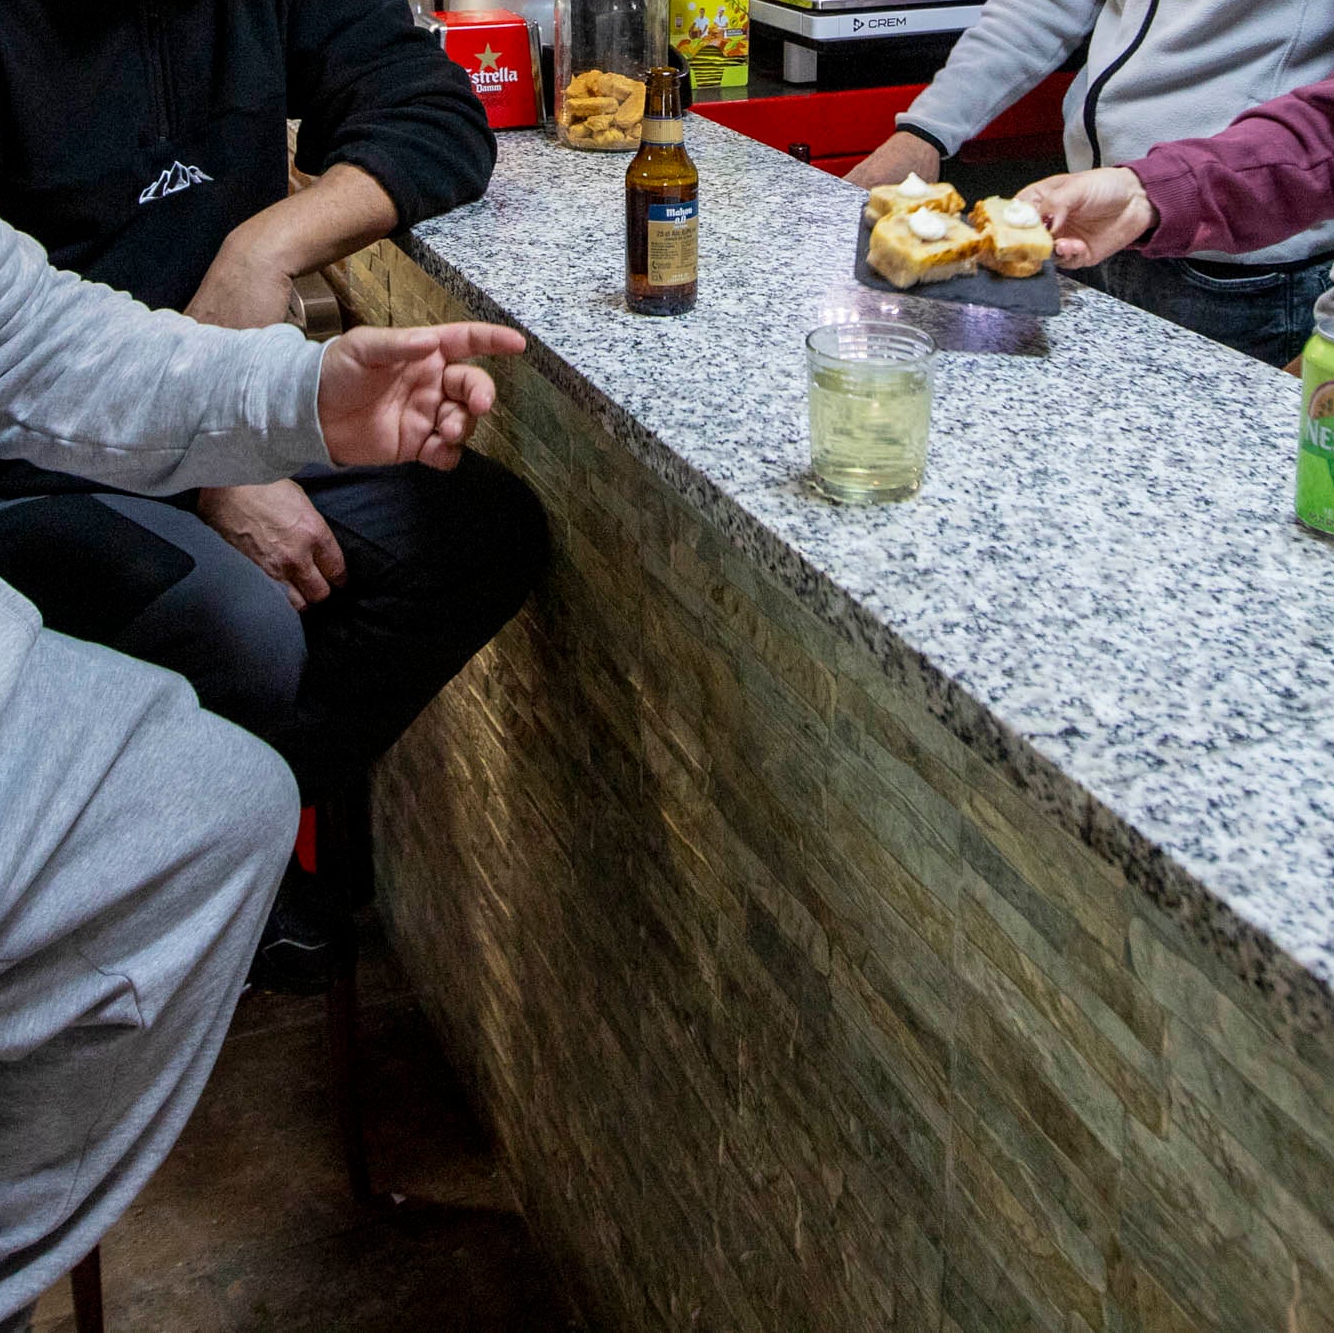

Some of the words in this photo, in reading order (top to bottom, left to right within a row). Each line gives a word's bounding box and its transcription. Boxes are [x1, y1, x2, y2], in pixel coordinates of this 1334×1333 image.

[868, 17, 907, 29] CREM
[476, 83, 503, 93] Damm
[666, 207, 693, 218] Mahou
